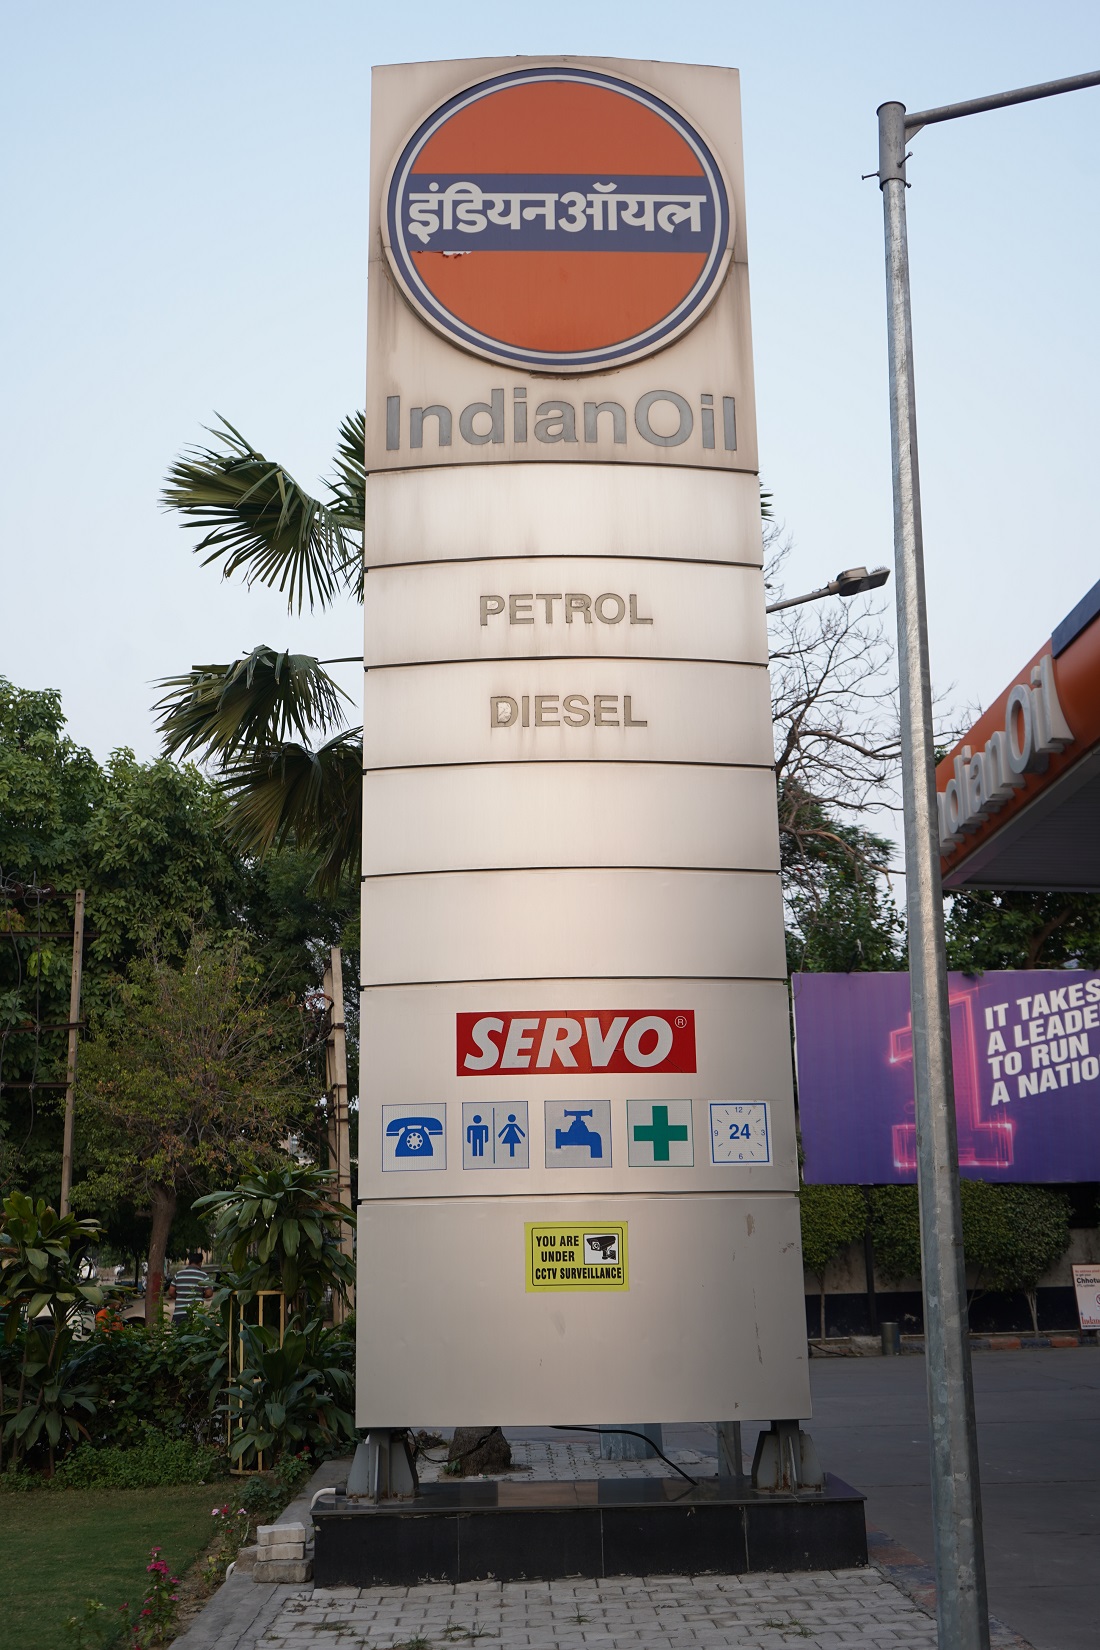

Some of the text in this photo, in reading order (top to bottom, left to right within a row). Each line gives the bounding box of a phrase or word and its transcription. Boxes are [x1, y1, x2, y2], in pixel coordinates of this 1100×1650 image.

[407, 181, 707, 245] इंडियनऑयल
[386, 387, 738, 451] IndianOil
[479, 593, 654, 626] PETROL
[490, 694, 648, 728] DIESEL
[985, 978, 1100, 1030] IT TAKES
[463, 1015, 674, 1070] SERVO
[987, 1003, 1100, 1056] A LEADE
[988, 1032, 1090, 1080] TO RUN
[991, 1054, 1100, 1106] A NATIO
[729, 1123, 751, 1140] 24
[536, 1235, 579, 1247] YOU ARE
[541, 1251, 575, 1262] UNDER
[535, 1267, 622, 1279] CCTV SURVEILLANCE
